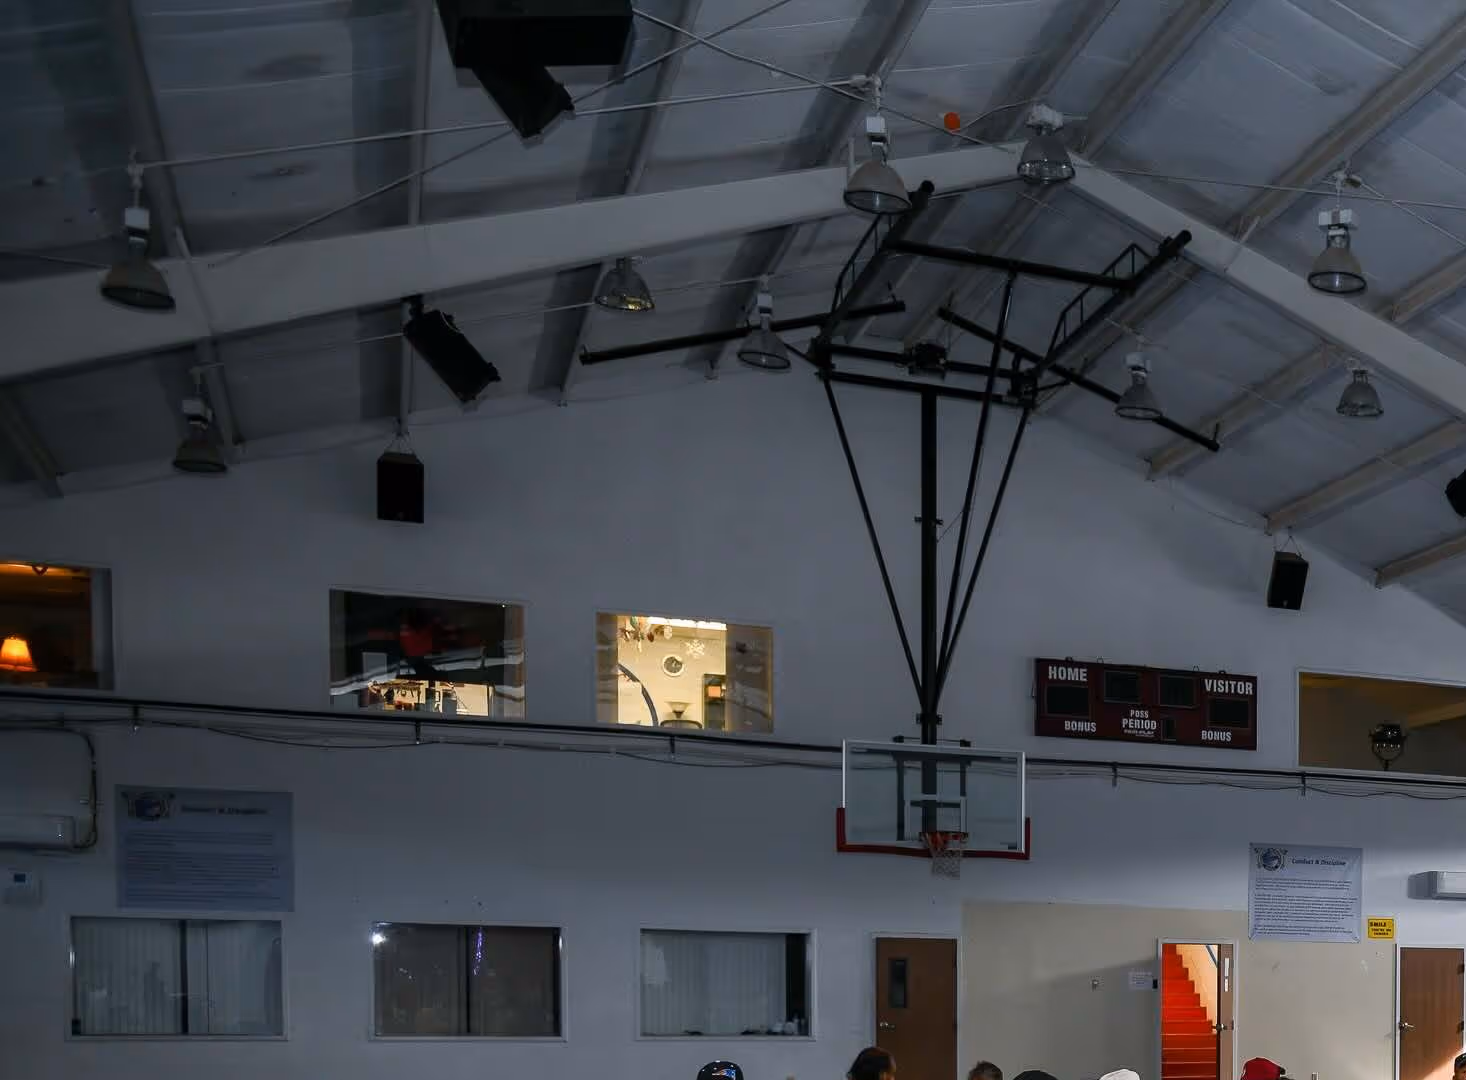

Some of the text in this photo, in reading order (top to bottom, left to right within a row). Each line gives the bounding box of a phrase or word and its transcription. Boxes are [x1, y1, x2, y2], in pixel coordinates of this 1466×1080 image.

[1048, 665, 1088, 682] HOME
[1204, 678, 1254, 696] VISITOR
[1130, 709, 1149, 718] POSS
[1064, 720, 1097, 733] BONUS
[1122, 718, 1157, 730] PERIOD
[1201, 730, 1232, 742] BONUS
